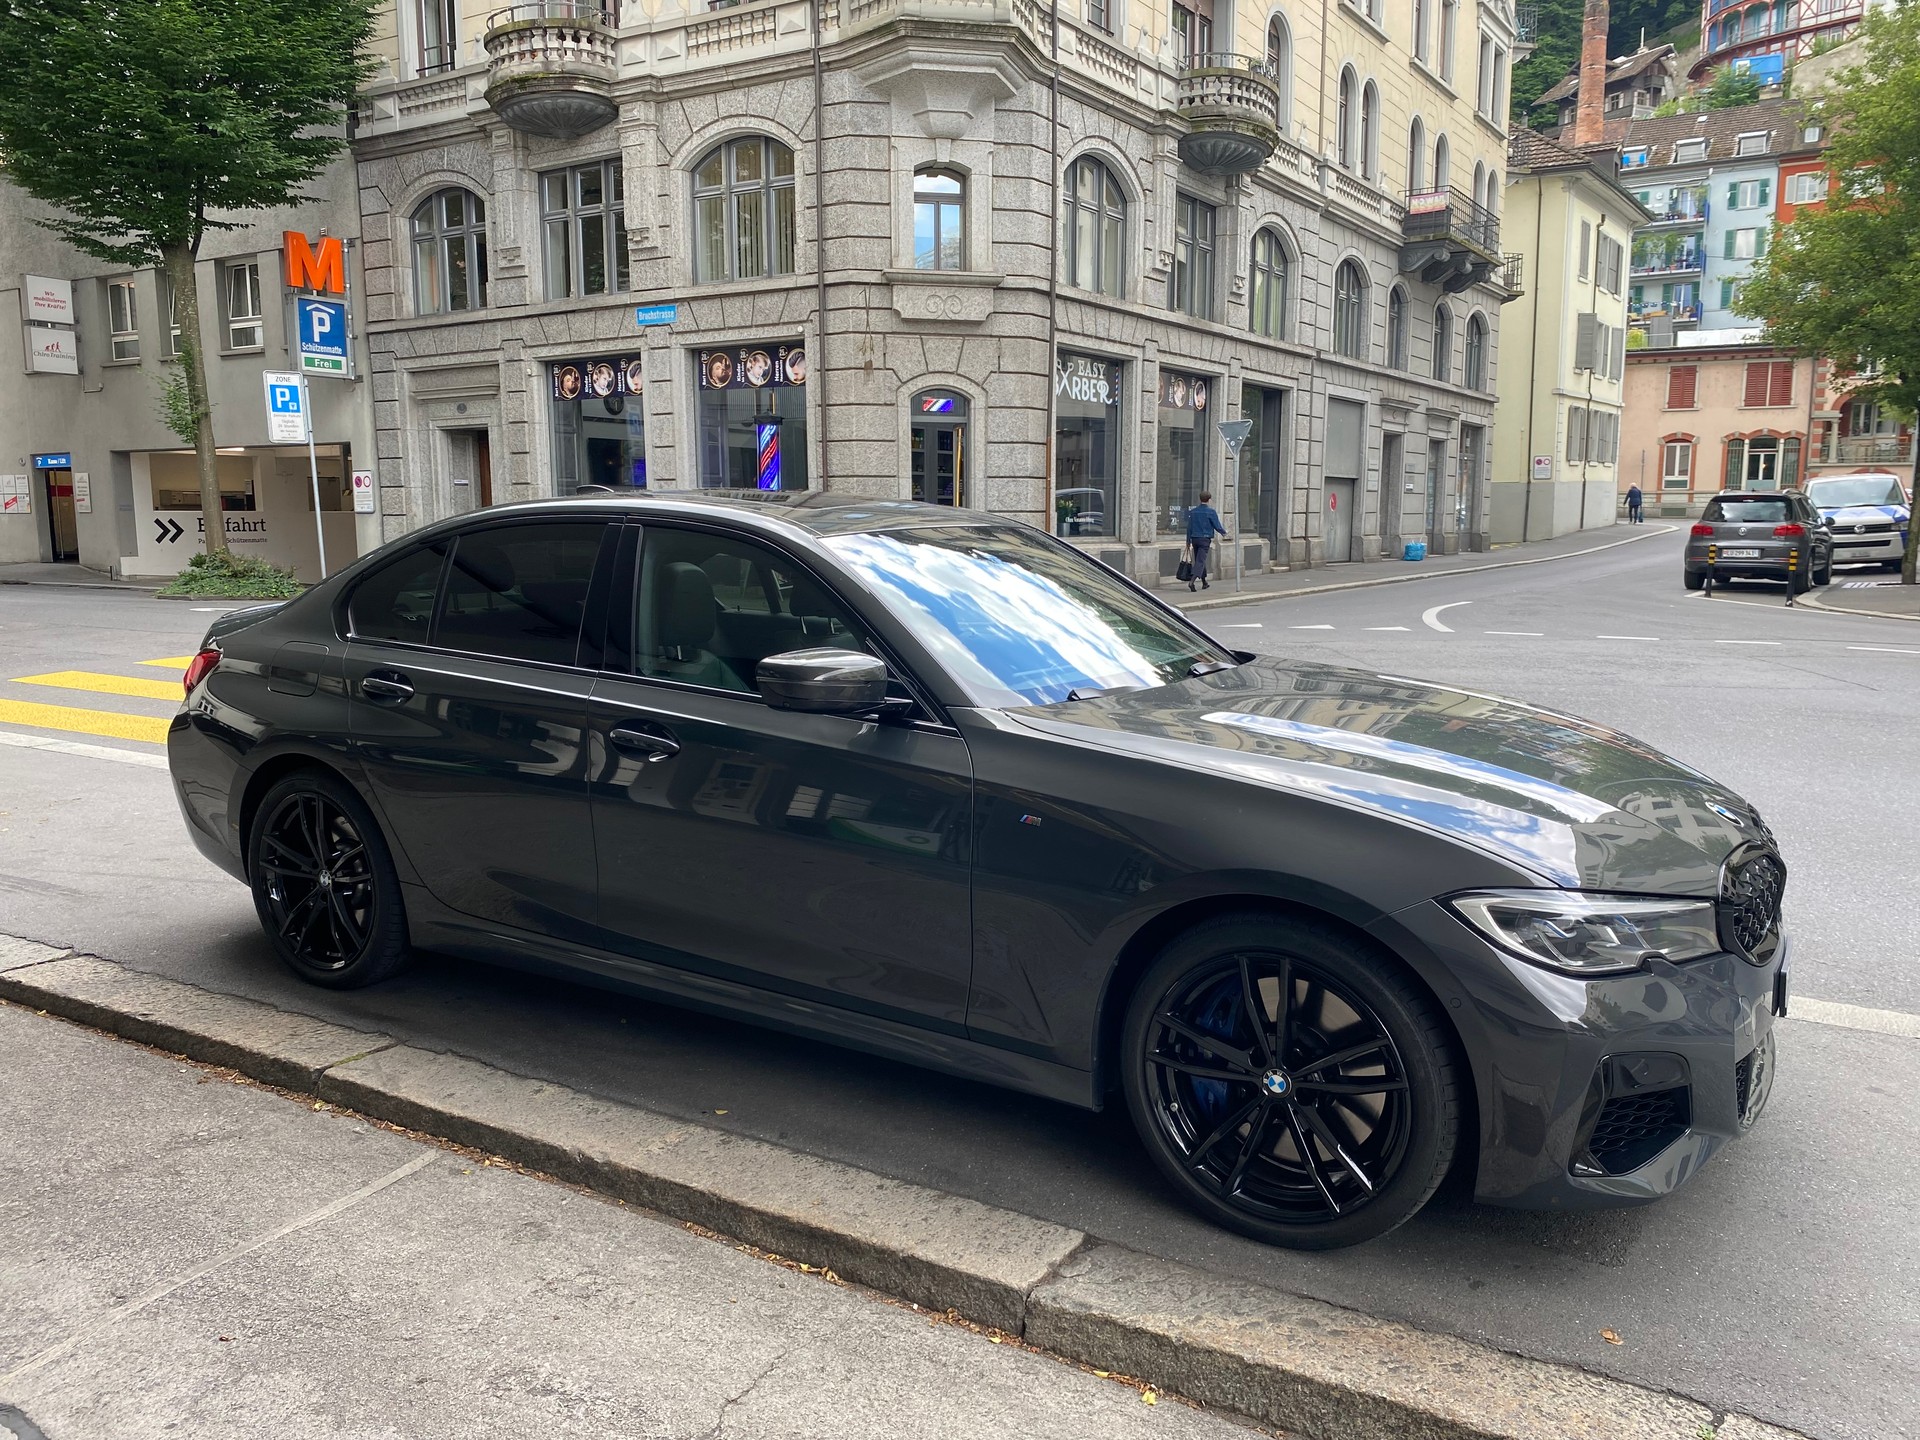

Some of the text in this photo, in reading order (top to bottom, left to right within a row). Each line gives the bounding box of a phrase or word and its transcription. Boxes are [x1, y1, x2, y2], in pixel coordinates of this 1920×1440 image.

[283, 230, 345, 293] M
[312, 311, 331, 343] P
[301, 342, 343, 355] Schützenmatte
[314, 358, 333, 369] Frei
[1077, 359, 1106, 379] EASY
[275, 387, 291, 409] P
[196, 517, 267, 532] Efahrt
